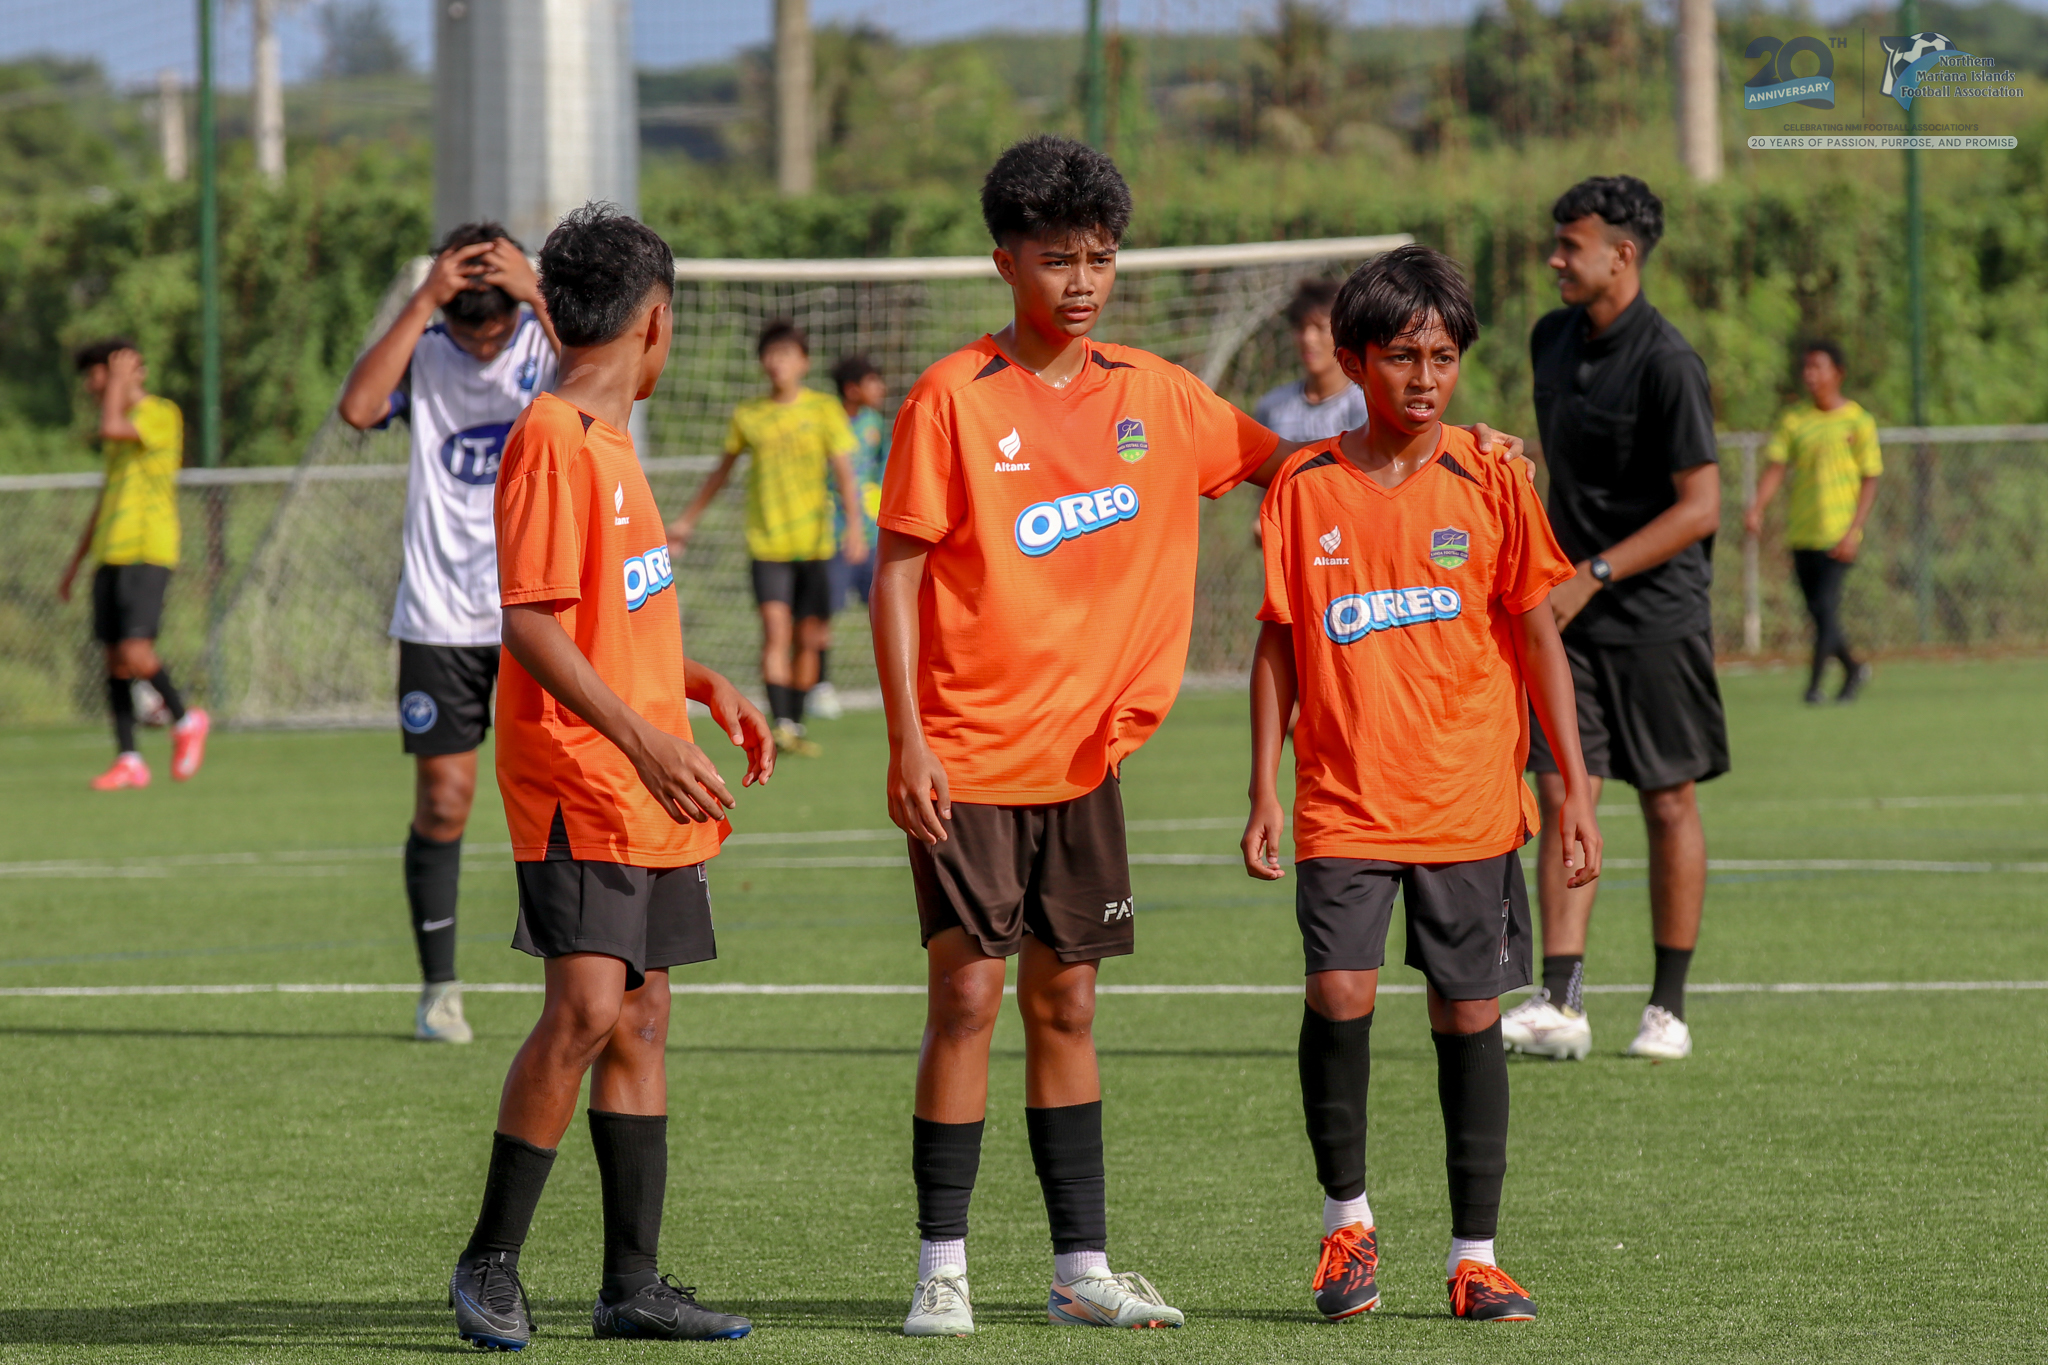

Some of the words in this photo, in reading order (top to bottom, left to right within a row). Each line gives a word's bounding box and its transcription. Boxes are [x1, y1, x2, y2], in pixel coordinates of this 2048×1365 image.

[450, 437, 507, 476] IT&
[994, 462, 1031, 472] Altanx
[1016, 485, 1138, 552] OREO
[623, 546, 673, 608] ORE
[1313, 556, 1350, 566] Altanx
[1326, 587, 1460, 641] OREO
